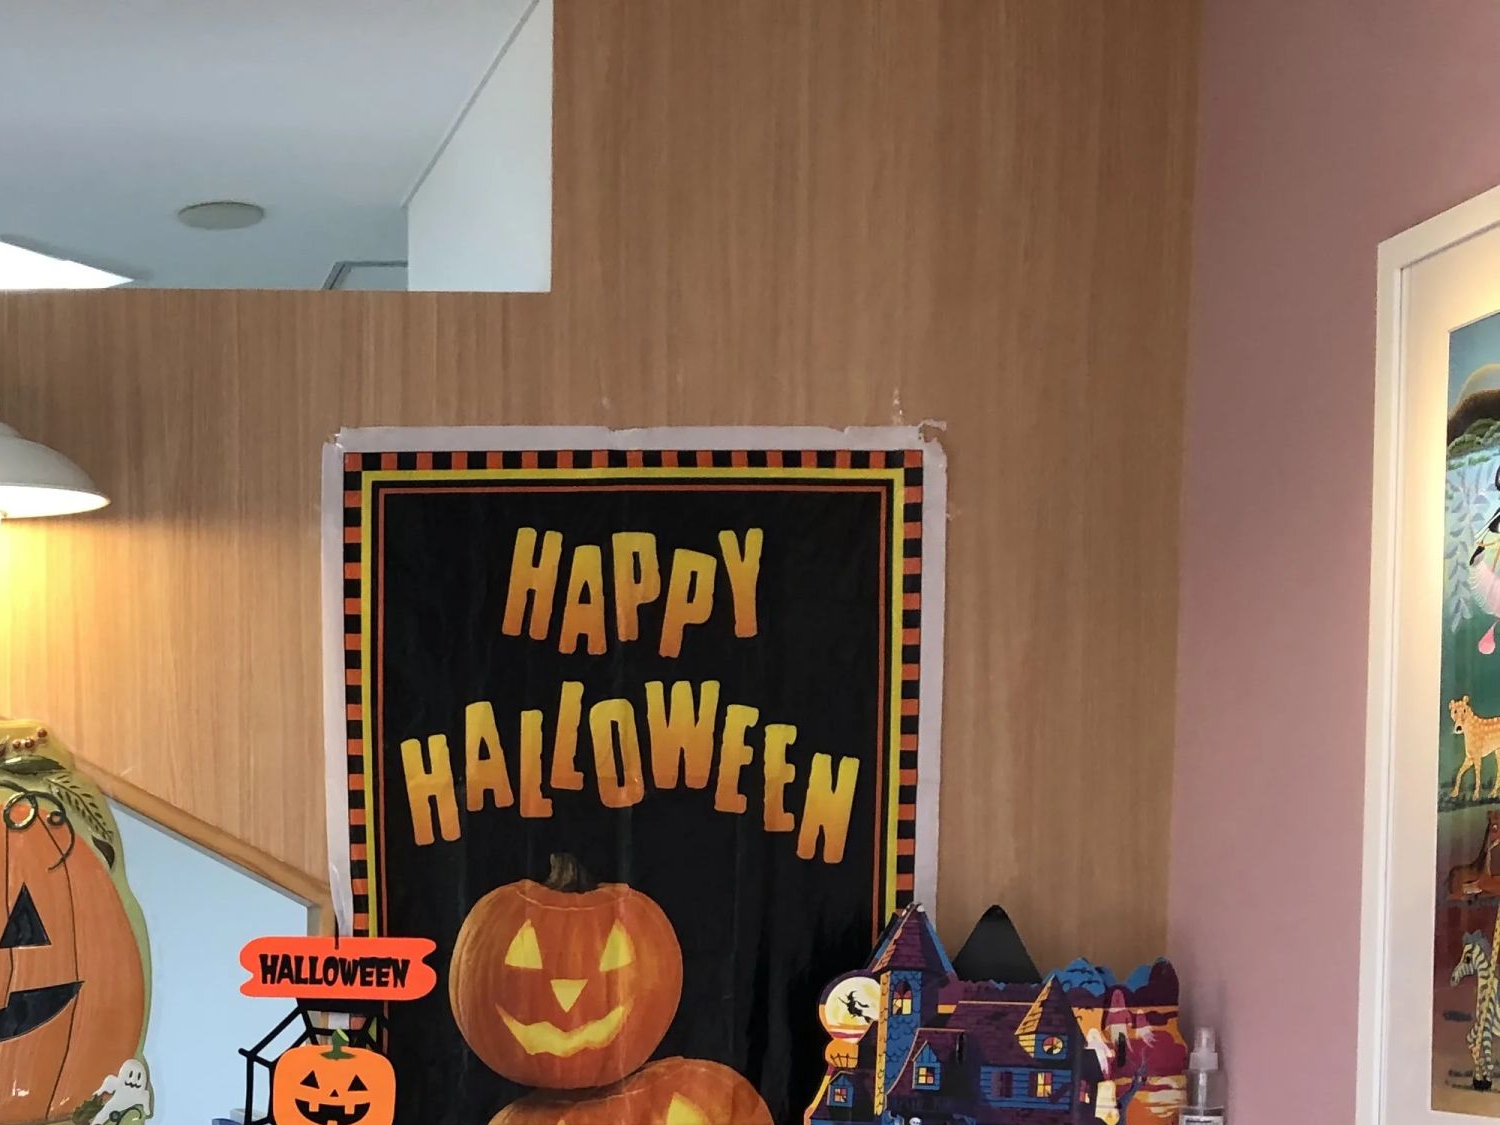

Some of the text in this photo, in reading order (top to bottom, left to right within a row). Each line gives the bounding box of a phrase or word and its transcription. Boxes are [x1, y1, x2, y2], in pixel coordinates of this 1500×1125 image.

[502, 527, 764, 658] HAPPY
[400, 680, 860, 864] HALLOWEEN
[259, 954, 410, 988] HALLOWEEN
